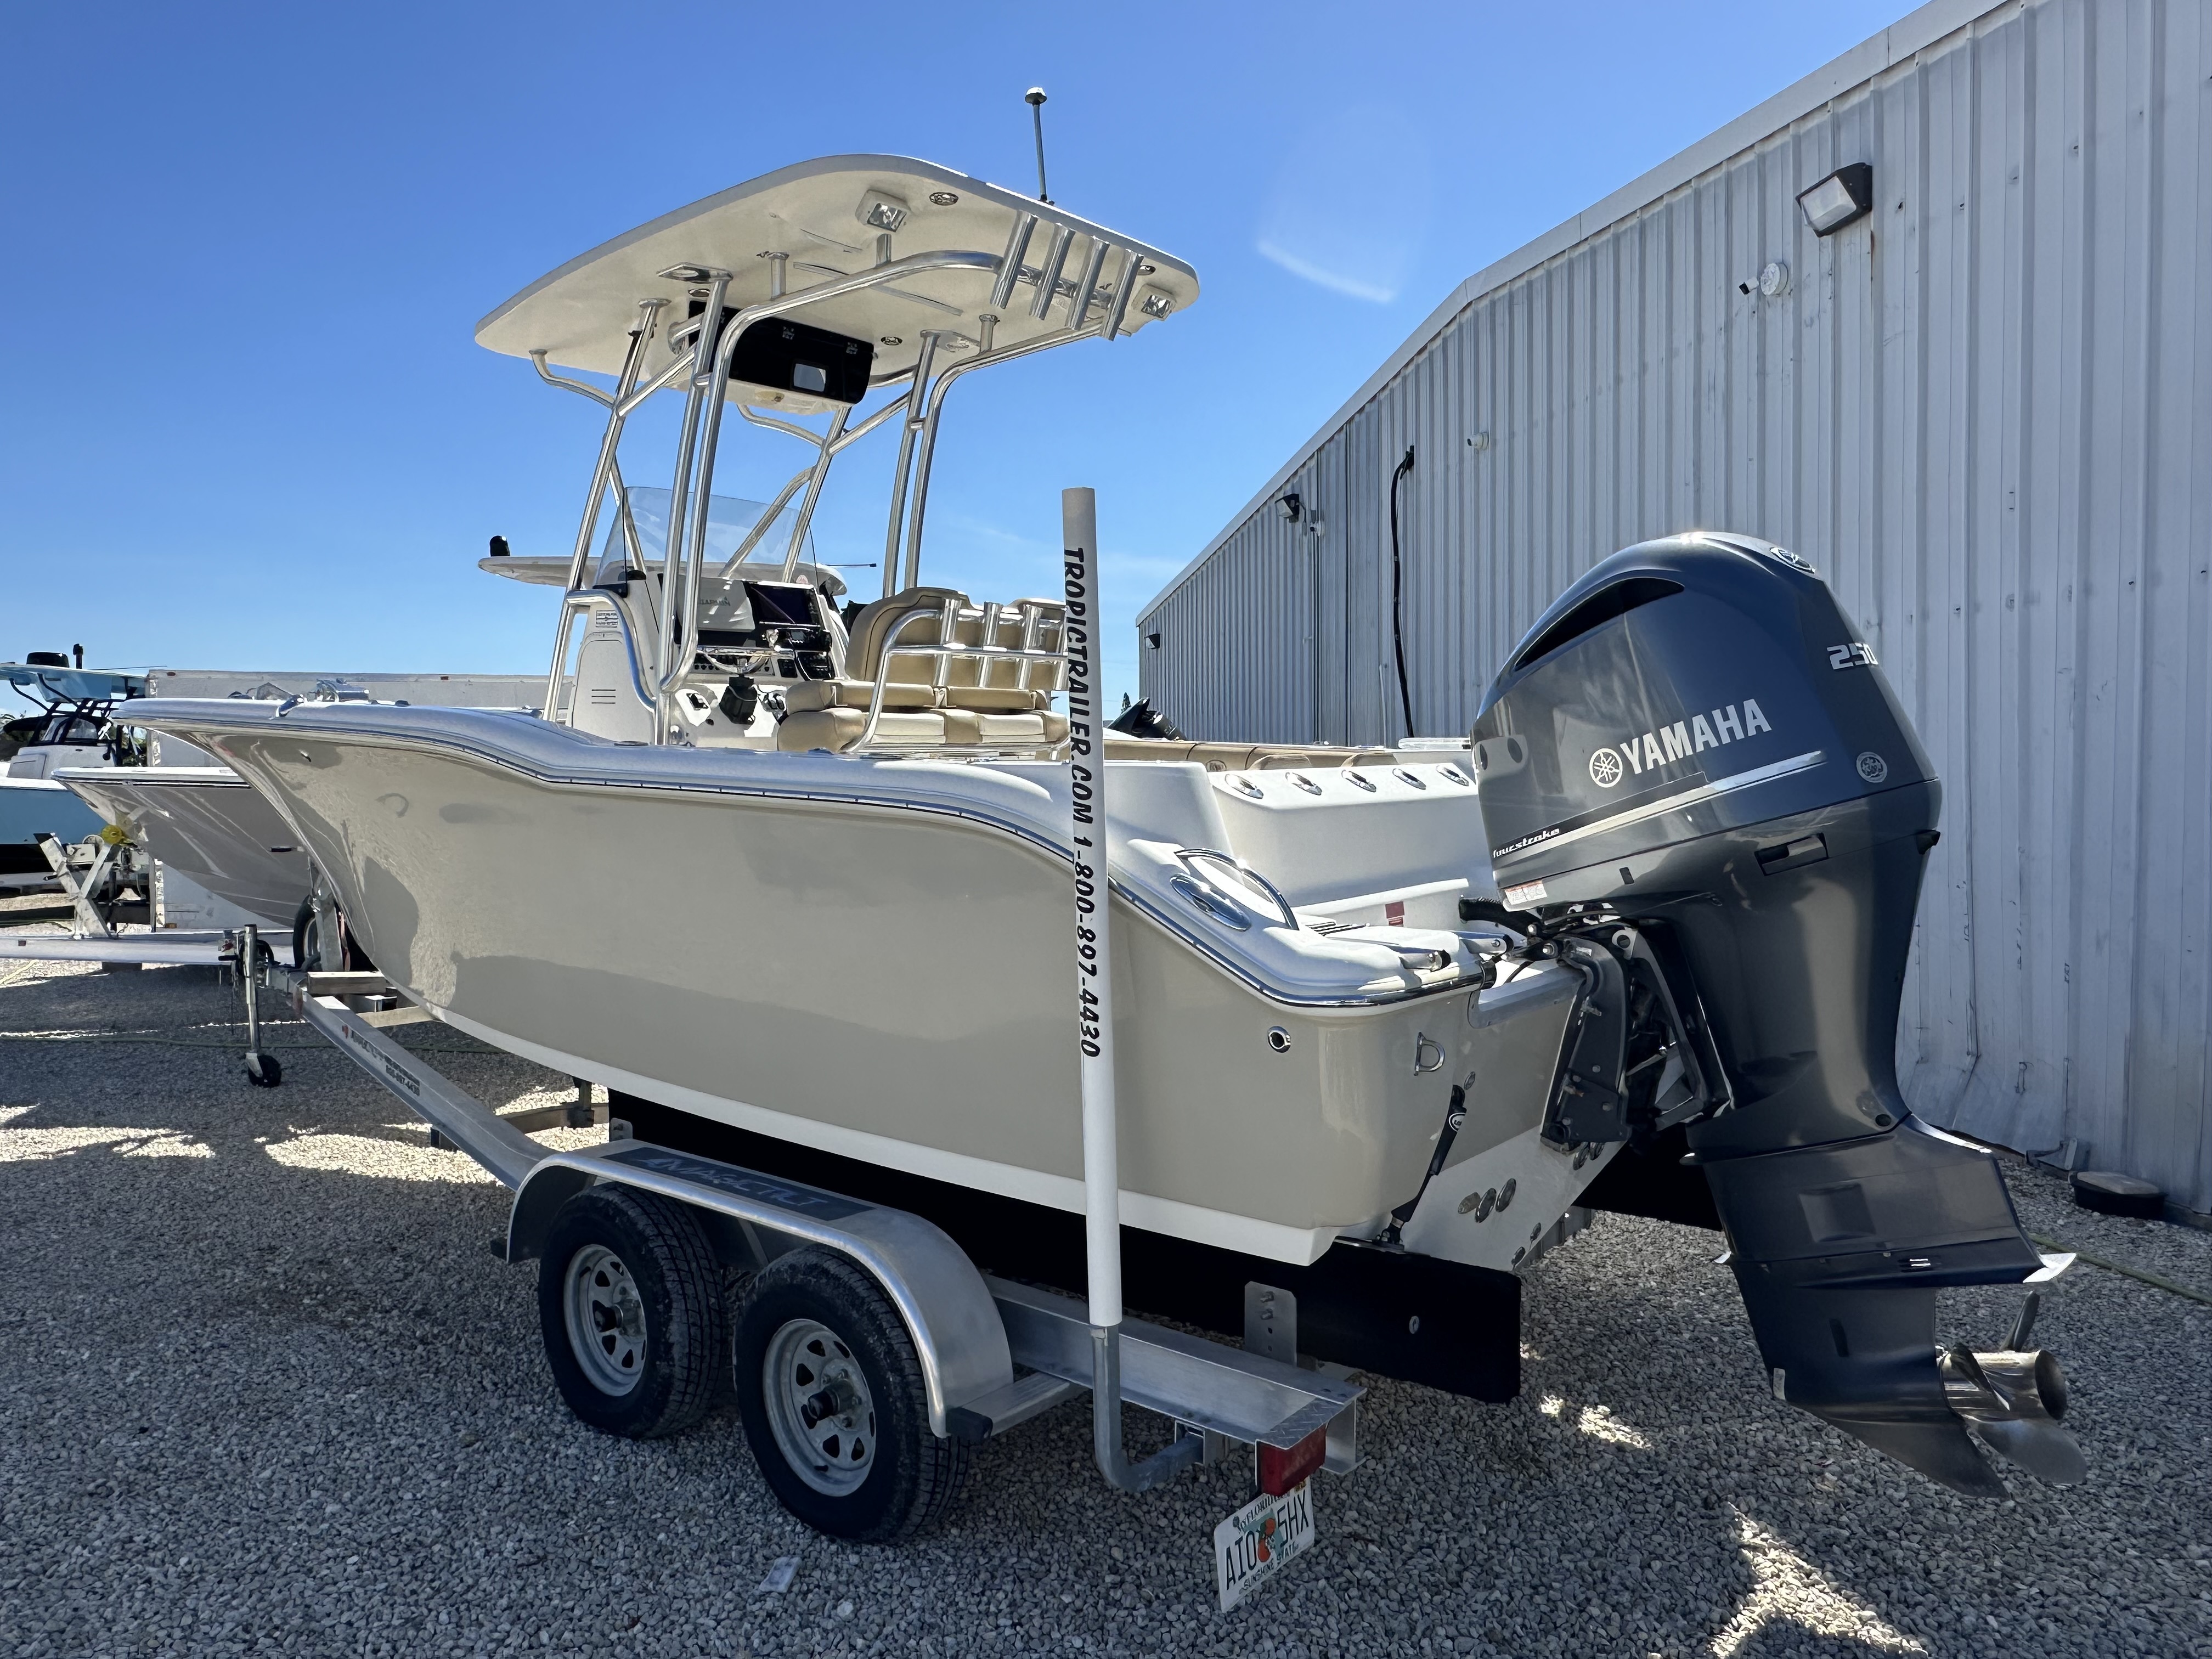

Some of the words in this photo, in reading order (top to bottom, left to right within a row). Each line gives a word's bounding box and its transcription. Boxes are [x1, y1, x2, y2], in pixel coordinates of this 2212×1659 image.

[1064, 548, 1093, 823] TROPICTRAILER.COM
[1826, 642, 1878, 670] 250
[1620, 698, 1772, 775] YAMAHA
[1074, 837, 1101, 1057] 1-800-897-4430
[1277, 1489, 1309, 1548] 5HX
